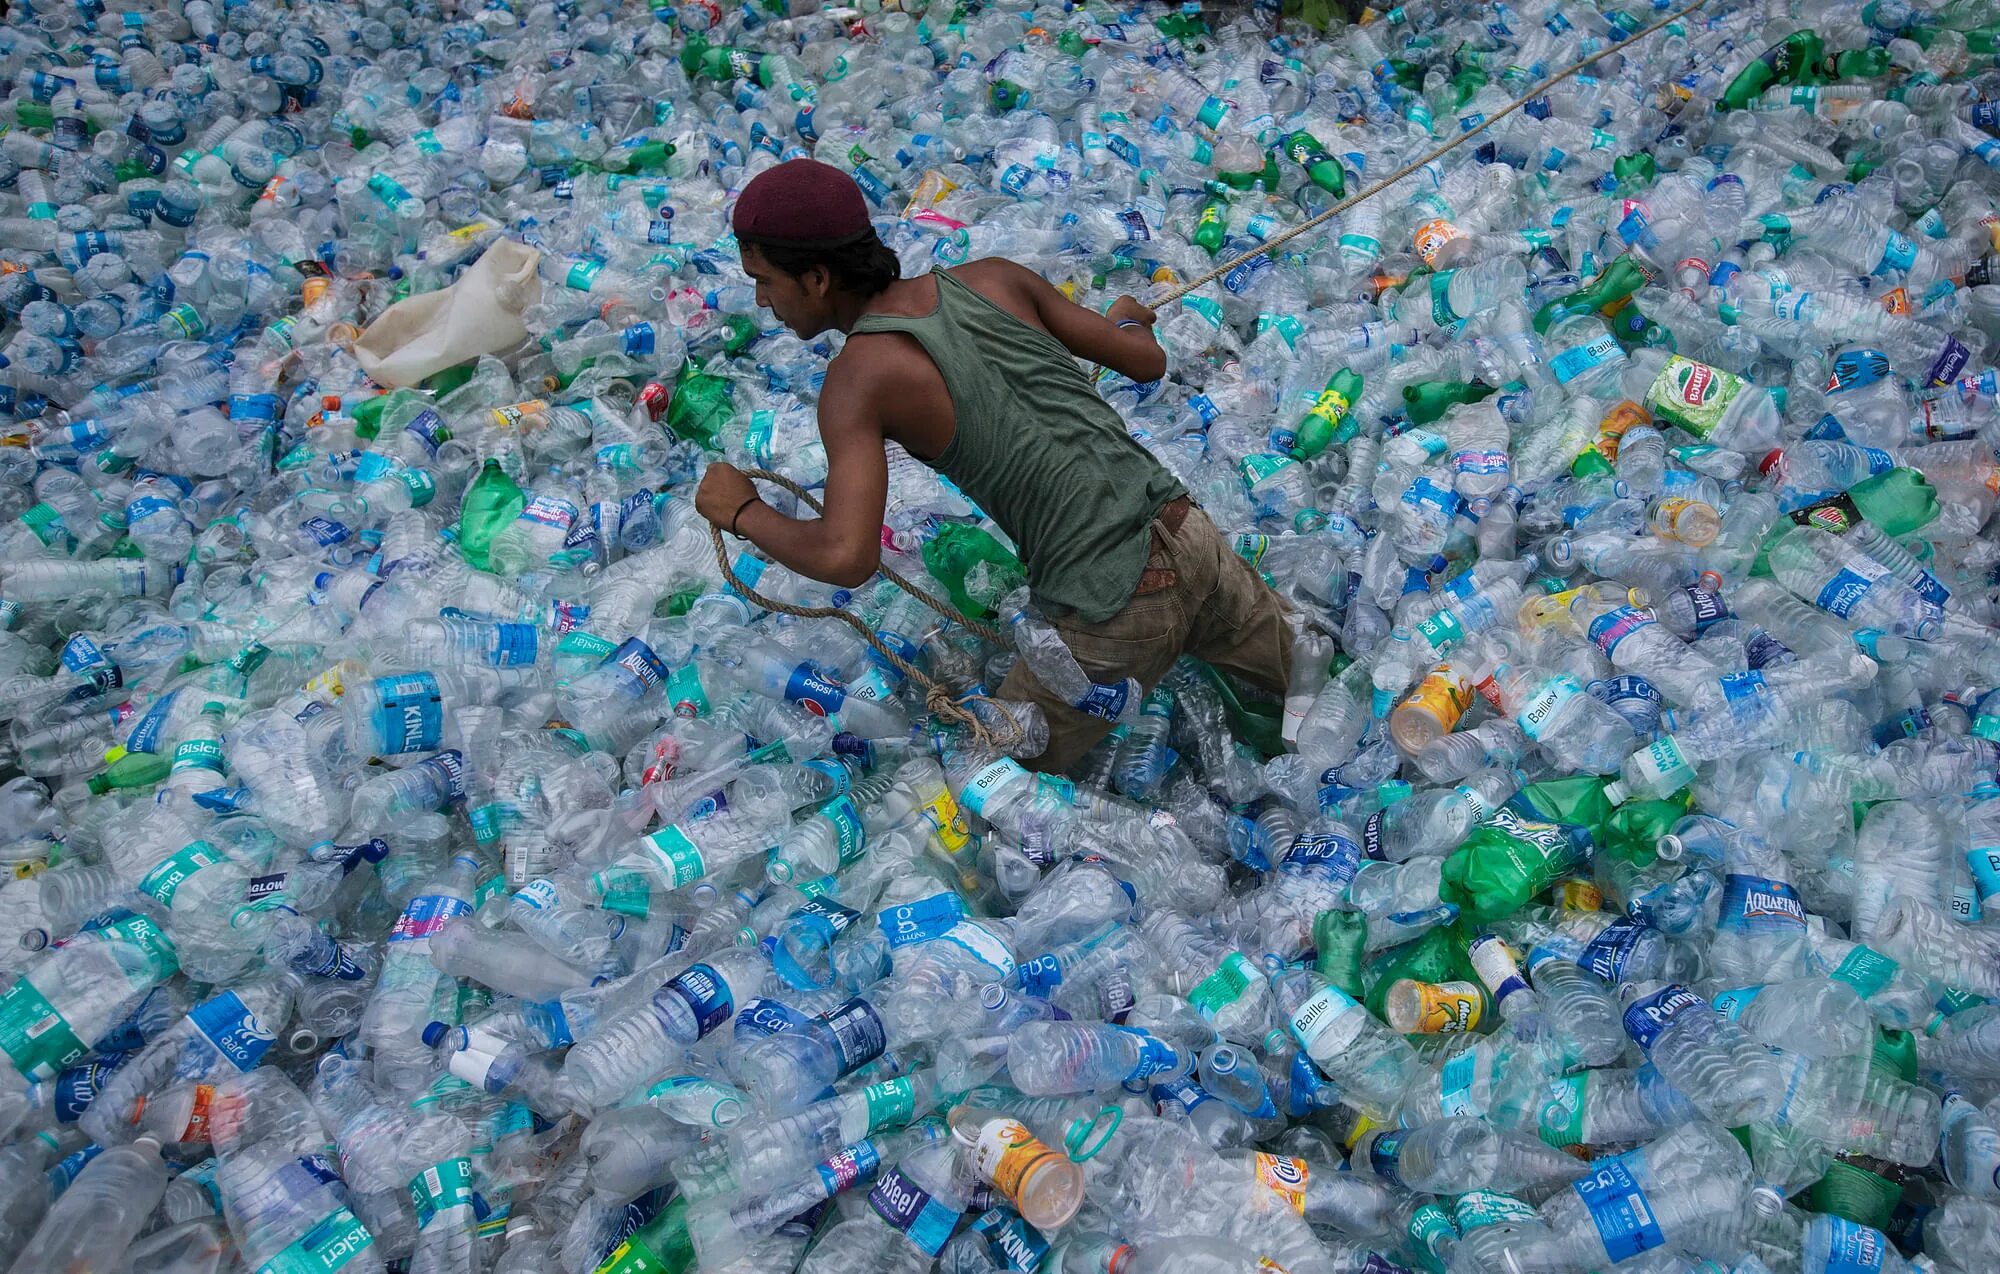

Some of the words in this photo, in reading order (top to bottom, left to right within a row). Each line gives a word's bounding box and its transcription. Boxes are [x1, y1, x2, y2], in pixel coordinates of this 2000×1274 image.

[1690, 361, 1712, 407] Limca
[1827, 582, 1857, 613] Valley
[1838, 583, 1867, 614] Mount
[803, 677, 833, 697] pepsi
[1527, 690, 1559, 725] Bailley
[975, 761, 1012, 790] Bailley
[837, 813, 851, 858] Bisleri
[251, 879, 286, 893] GLOW
